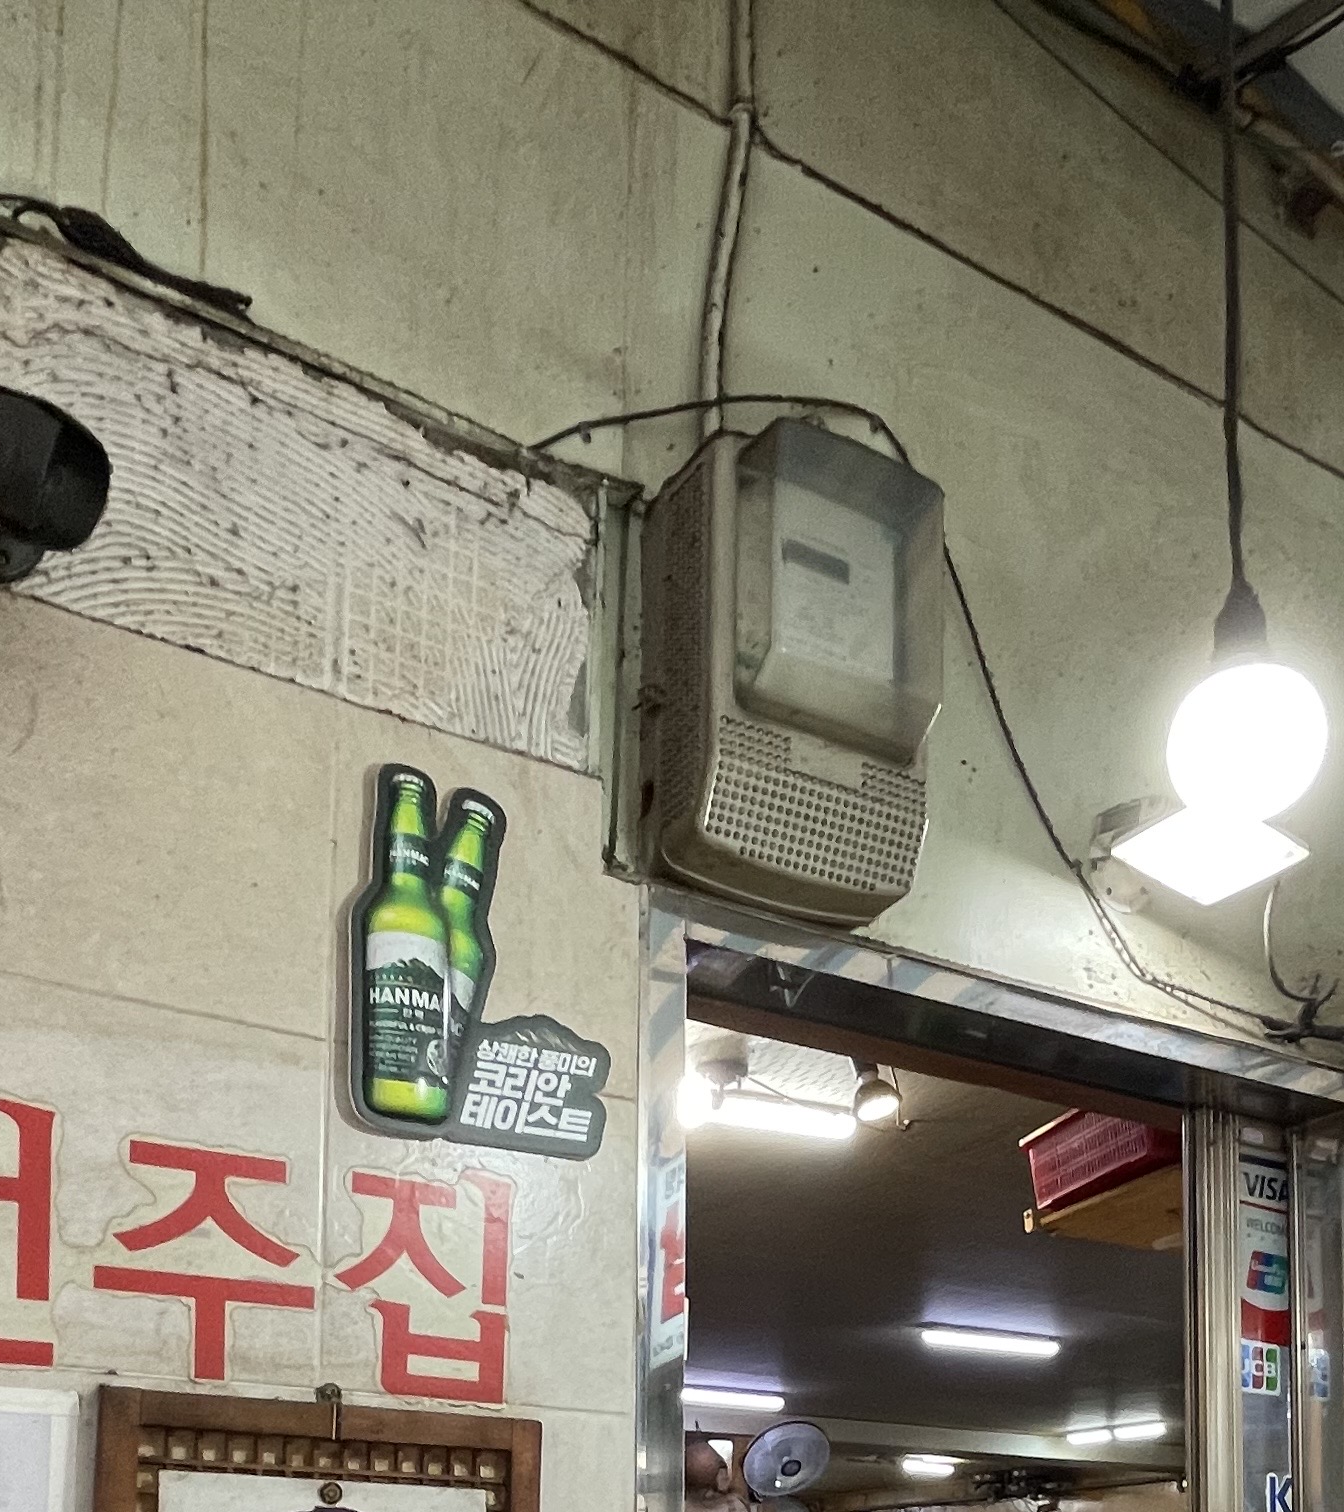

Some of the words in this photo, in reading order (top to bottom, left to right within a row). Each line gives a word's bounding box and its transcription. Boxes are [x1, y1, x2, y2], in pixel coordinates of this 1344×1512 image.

[538, 1049, 597, 1078] 풍미의
[468, 1060, 572, 1107] 코리안
[460, 1092, 593, 1142] 테이스트
[1243, 1172, 1289, 1201] VISA
